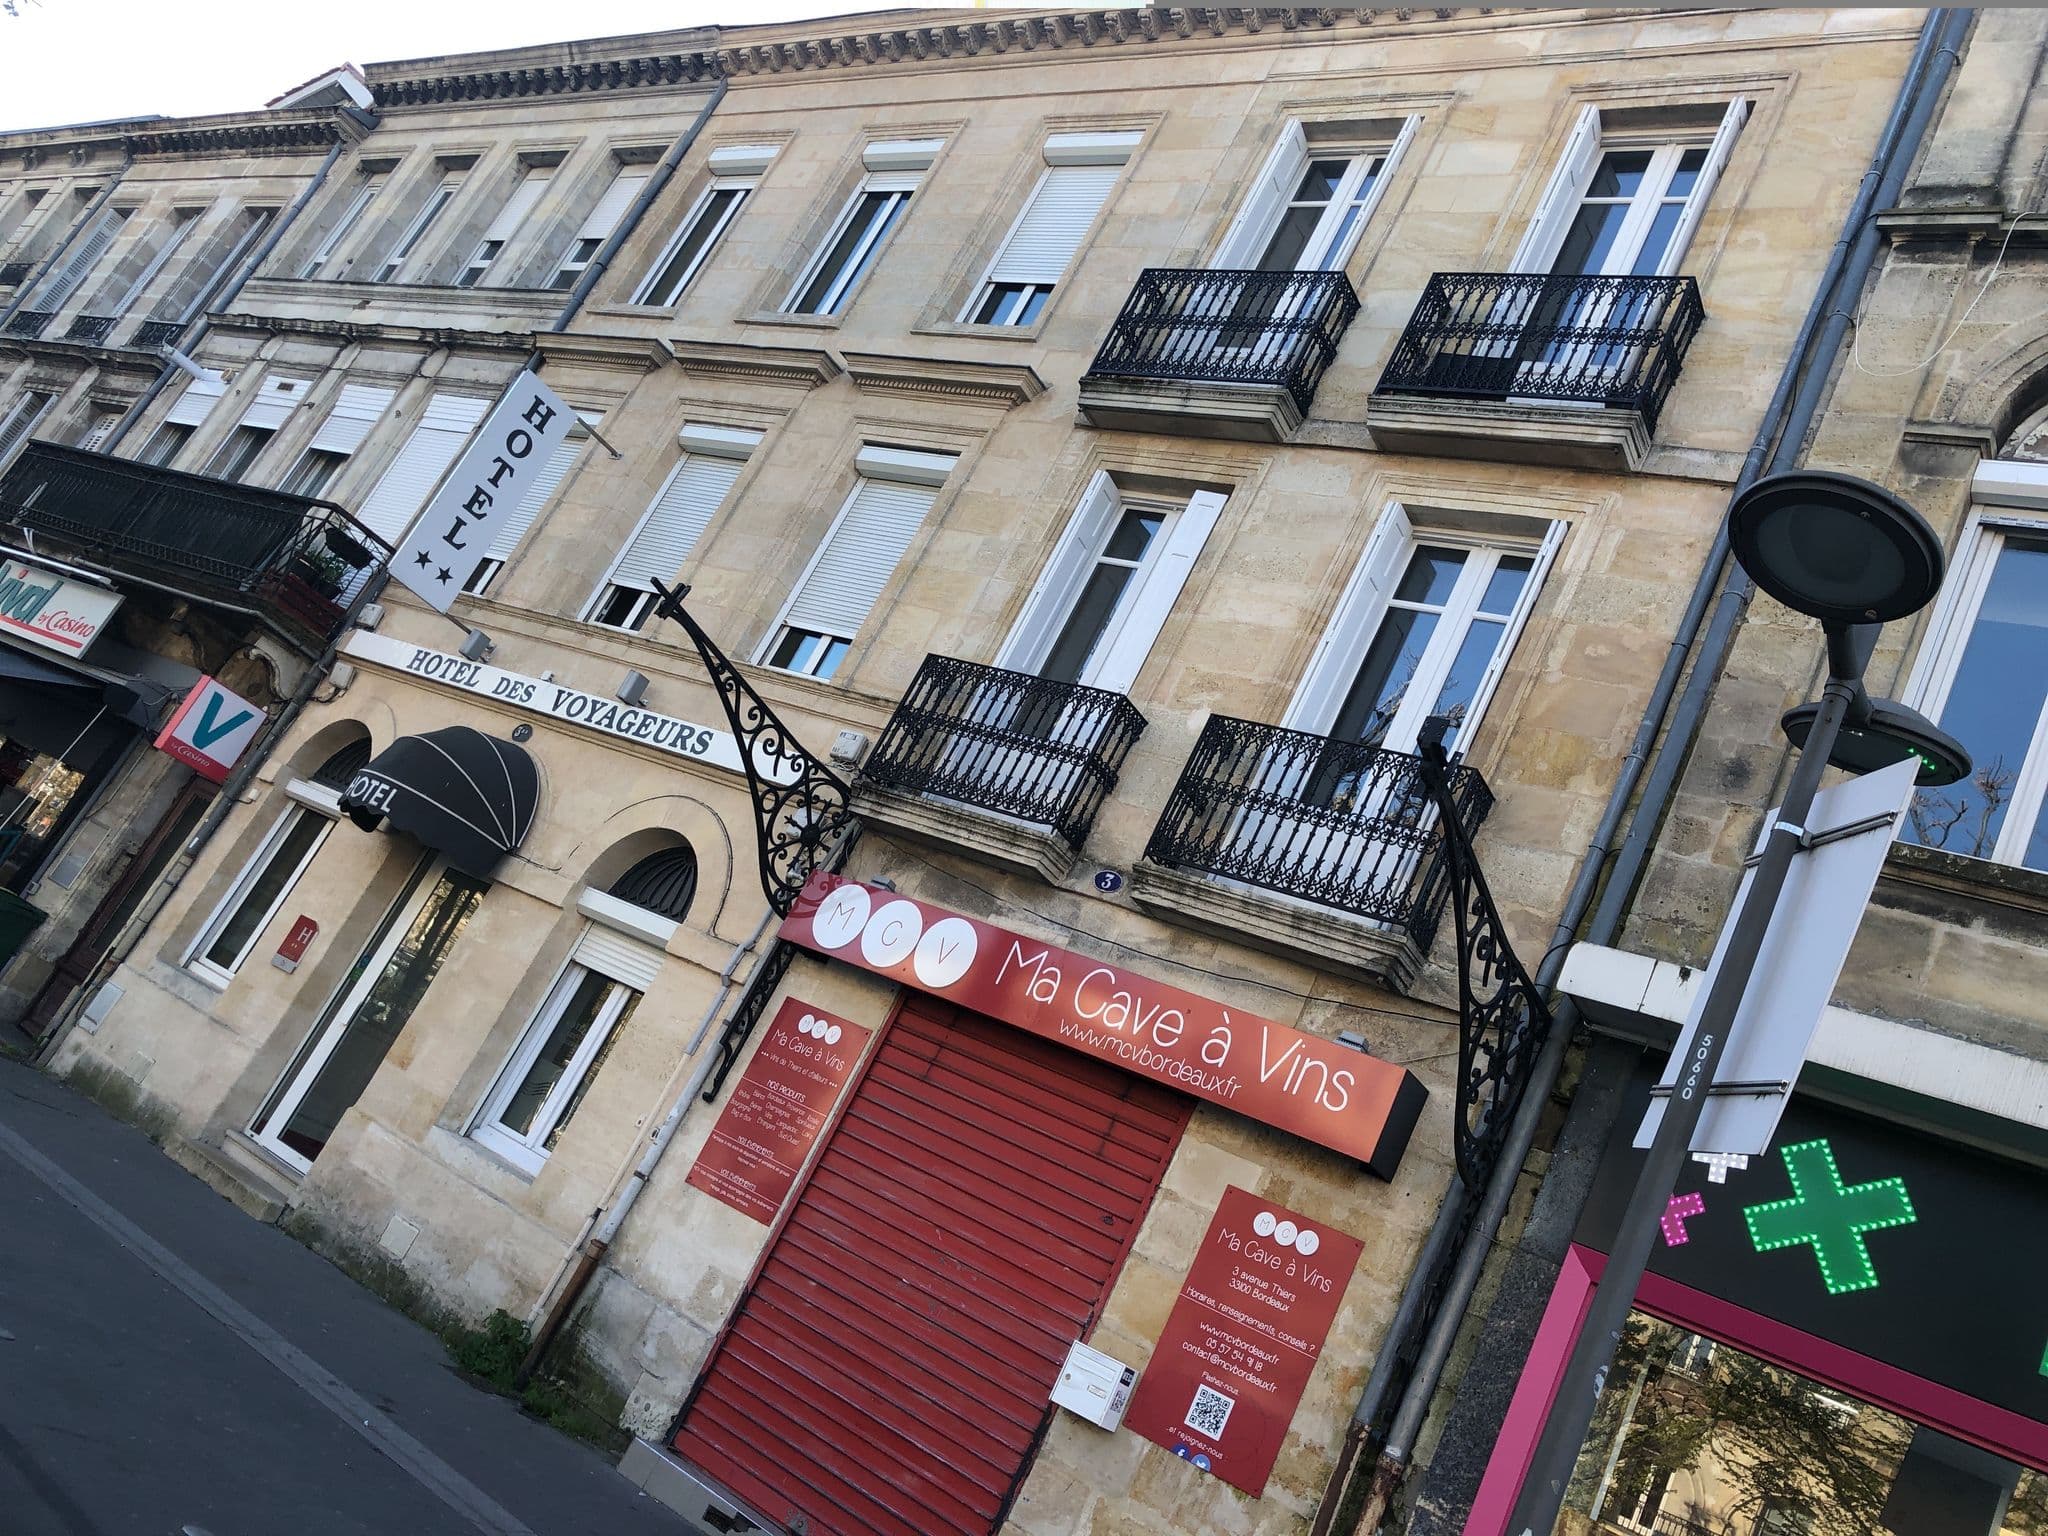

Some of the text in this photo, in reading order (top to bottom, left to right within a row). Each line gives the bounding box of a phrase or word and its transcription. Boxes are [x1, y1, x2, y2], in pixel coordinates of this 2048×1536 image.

[442, 395, 557, 550] HOTEL
[45, 610, 96, 637] Casino
[192, 691, 254, 750] V
[406, 649, 714, 756] HOTEL DES VOYAGEURS
[177, 745, 210, 767] Casino
[344, 774, 398, 813] HOTEL
[1101, 873, 1115, 888] 3
[296, 926, 313, 945] H
[995, 940, 1355, 1112] Ma Cave à Vins
[771, 1028, 788, 1046] Ma
[788, 1036, 813, 1057] Cave
[814, 1047, 823, 1061] à
[825, 1051, 845, 1071] Vins
[1682, 1034, 1714, 1100] 50660
[766, 1079, 780, 1090] NOS
[778, 1084, 806, 1102] PRODUITS
[1217, 1227, 1332, 1292] Ma Cave à Vins
[1228, 1277, 1289, 1312] 33100 Bordeaux
[1232, 1265, 1296, 1302] 3 avenue Thiers
[1205, 1337, 1217, 1349] 05
[1217, 1343, 1231, 1354] 57
[1231, 1349, 1244, 1362] 54
[1277, 1331, 1307, 1350] conseils
